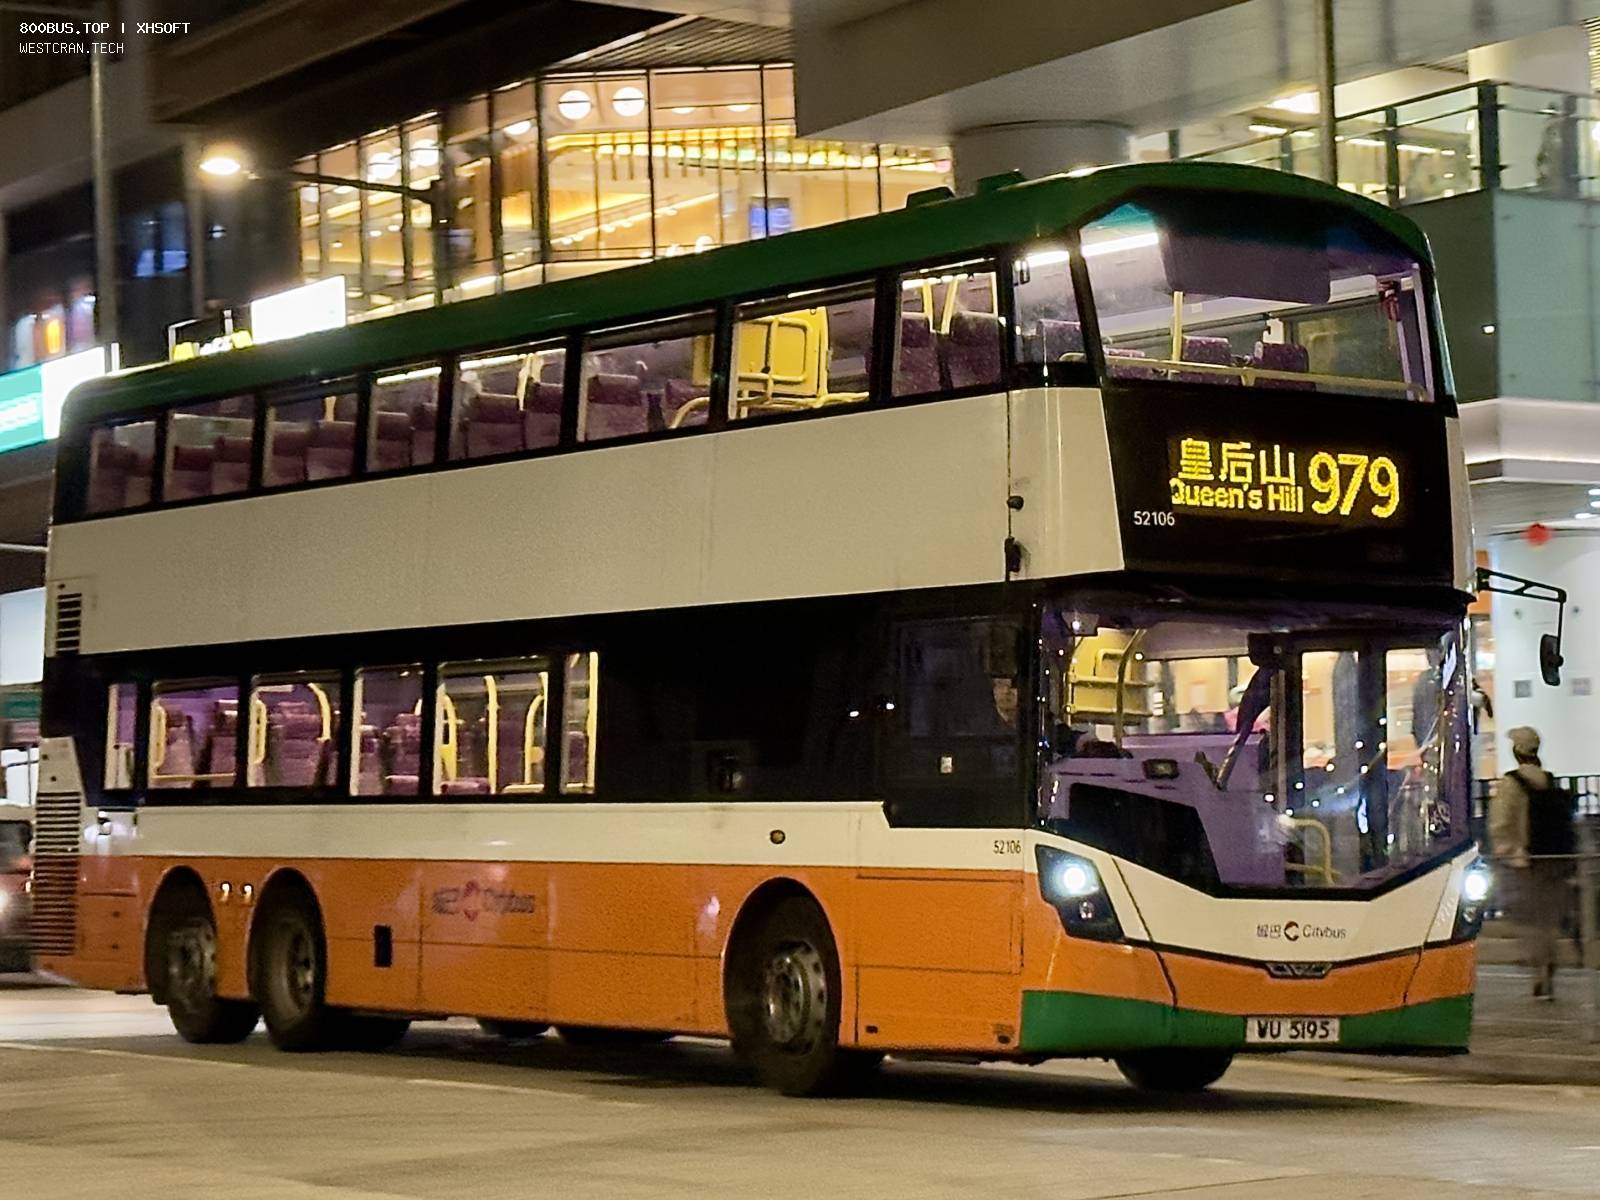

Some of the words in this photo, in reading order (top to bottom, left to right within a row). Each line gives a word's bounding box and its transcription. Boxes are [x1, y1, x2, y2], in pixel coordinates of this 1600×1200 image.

[1178, 438, 1295, 485] 皇后山
[1169, 477, 1263, 510] Queen's
[1267, 484, 1304, 513] Hill
[1308, 451, 1400, 518] 979
[1133, 510, 1176, 527] 52106
[993, 839, 1022, 855] 52106
[1289, 1019, 1330, 1040] 5195
